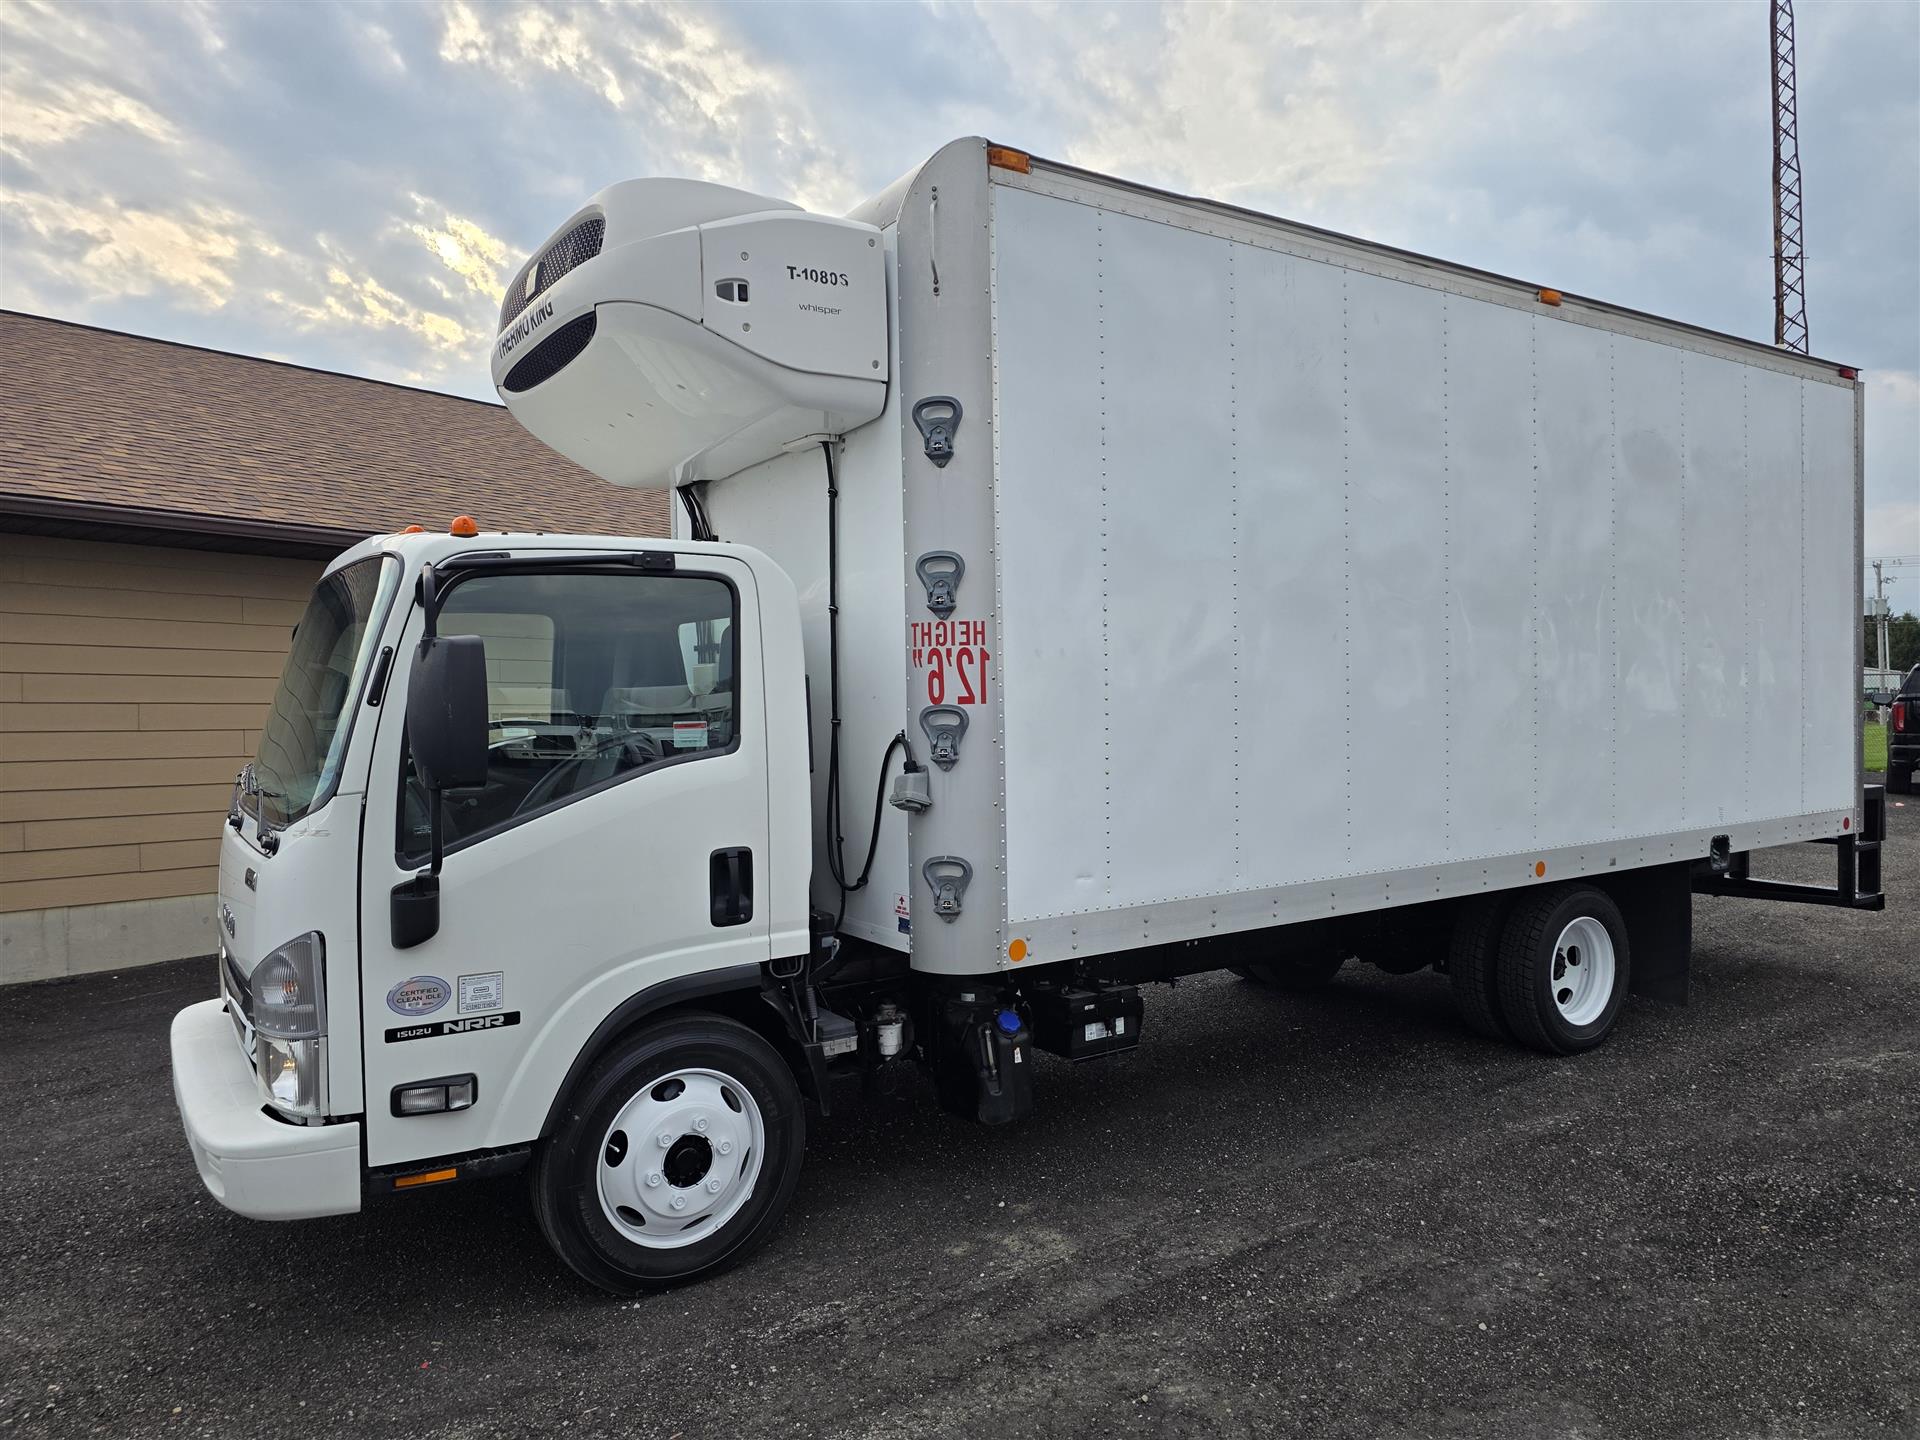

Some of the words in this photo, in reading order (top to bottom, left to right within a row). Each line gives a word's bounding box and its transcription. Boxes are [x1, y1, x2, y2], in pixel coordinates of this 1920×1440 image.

[786, 265, 848, 287] T-1080S
[799, 303, 842, 315] whisper
[497, 314, 530, 359] THERMO
[530, 293, 554, 331] KING
[396, 995, 423, 1004] CLEAN
[400, 987, 439, 997] CERTIFIED
[397, 1027, 432, 1038] ISUZU
[443, 1015, 504, 1034] NRR
